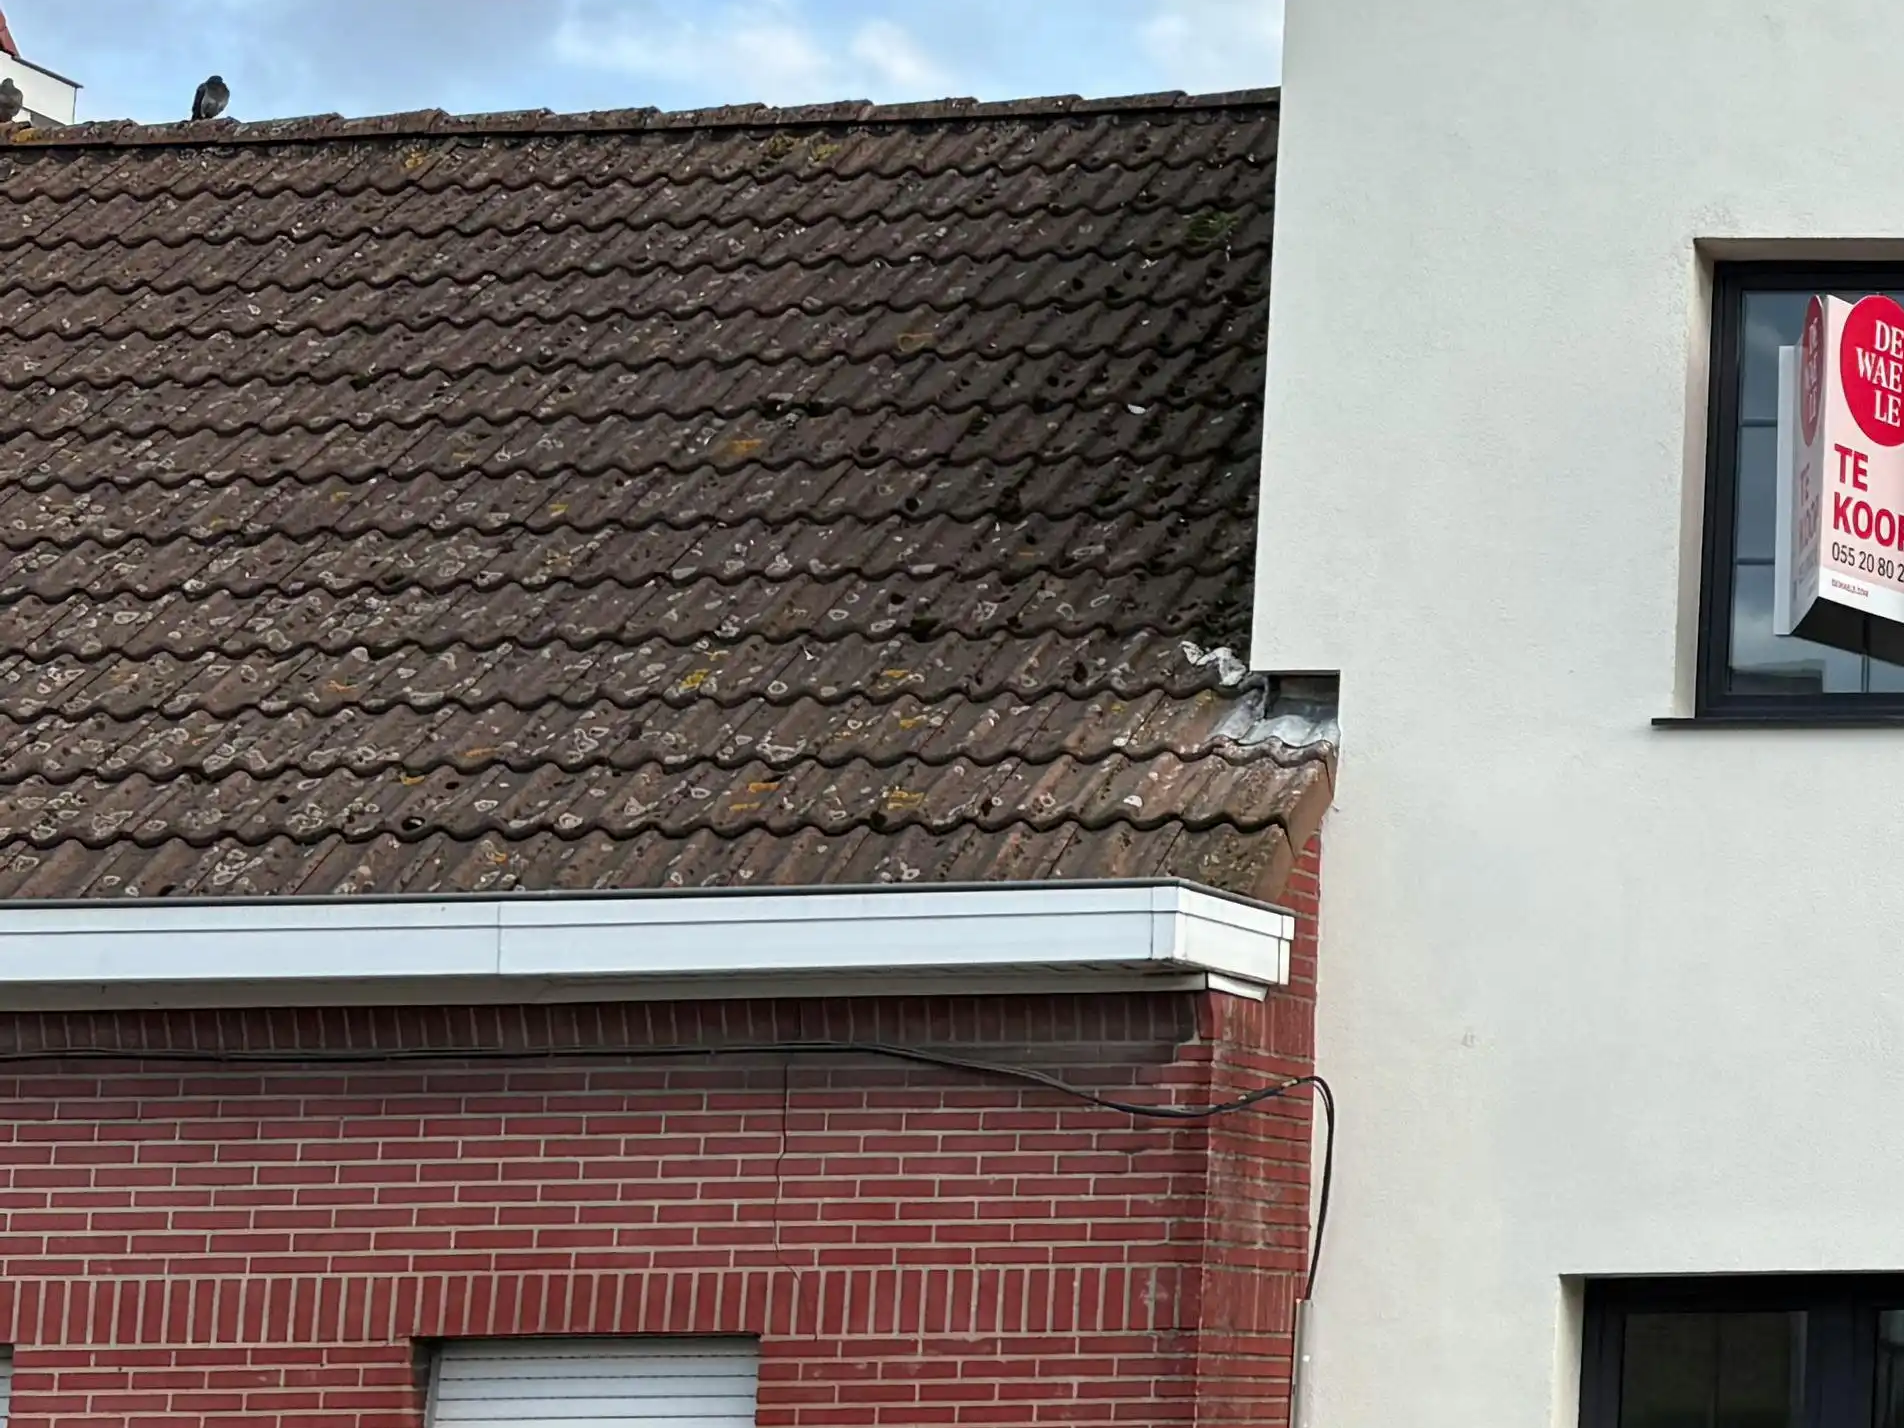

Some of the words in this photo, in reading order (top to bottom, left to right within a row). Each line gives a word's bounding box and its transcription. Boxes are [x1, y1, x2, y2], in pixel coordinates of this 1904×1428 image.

[1874, 319, 1904, 359] DE
[1855, 346, 1903, 393] WAE
[1874, 389, 1902, 427] LE
[1834, 443, 1869, 492] TE
[1832, 541, 1855, 567] 055
[1858, 550, 1875, 573] 20
[1877, 557, 1894, 579] 80
